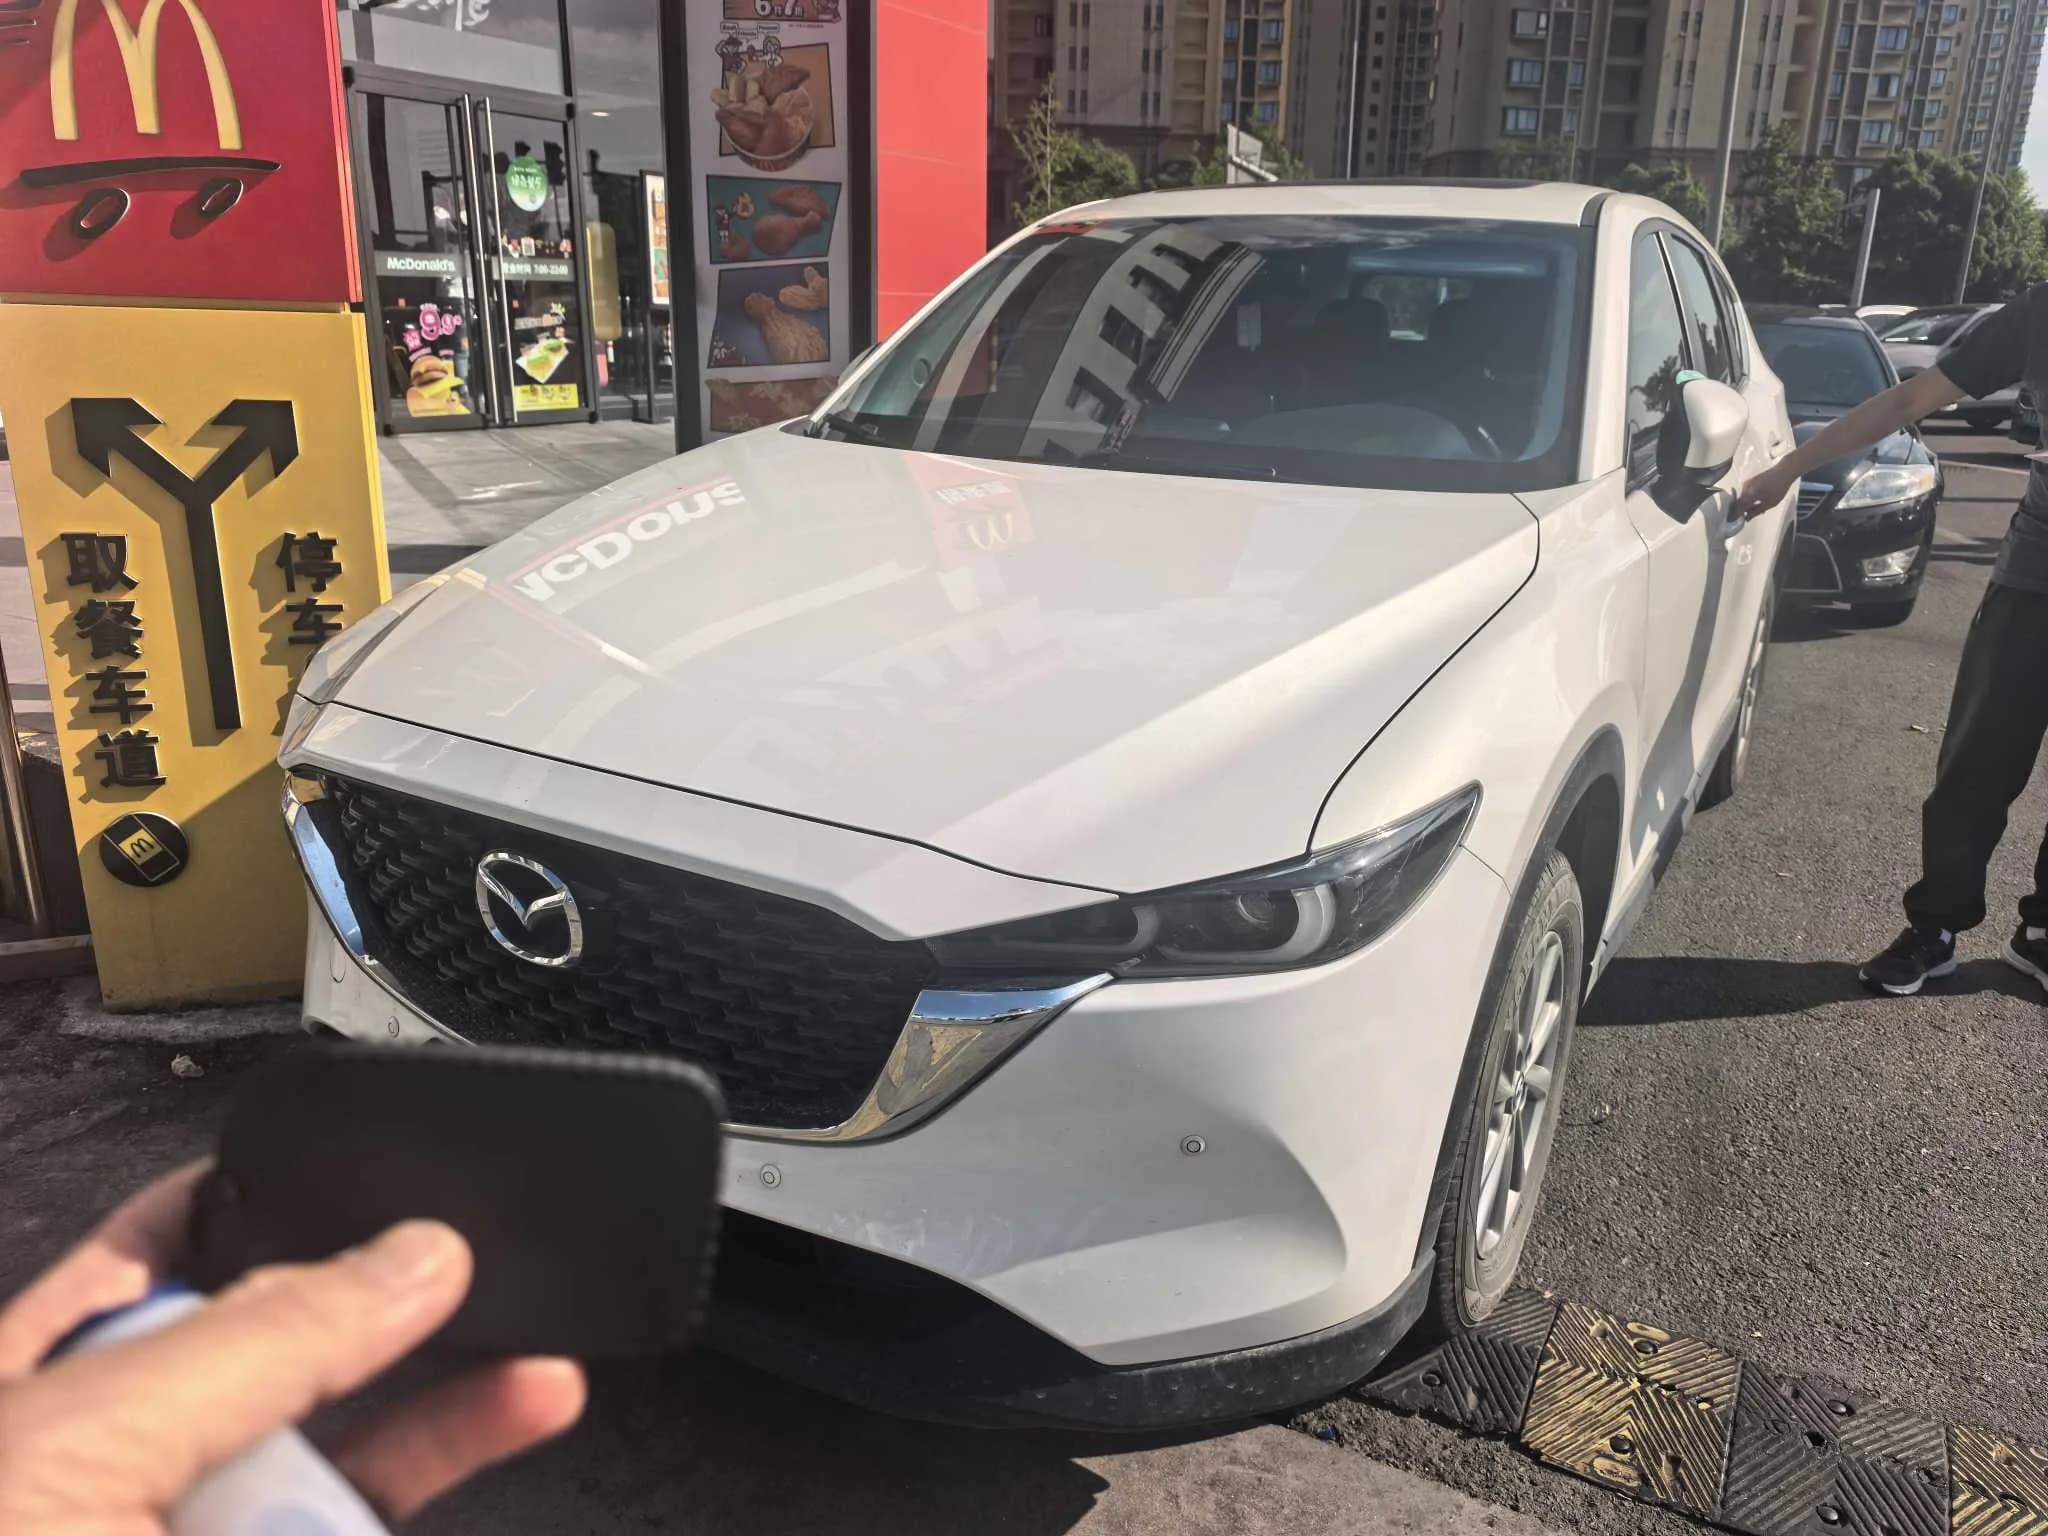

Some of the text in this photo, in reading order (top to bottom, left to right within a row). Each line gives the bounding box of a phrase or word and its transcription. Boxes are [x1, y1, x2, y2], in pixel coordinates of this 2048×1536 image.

[387, 257, 455, 272] McDonald's
[276, 531, 344, 646] 停车
[60, 533, 167, 787] 取餐车道
